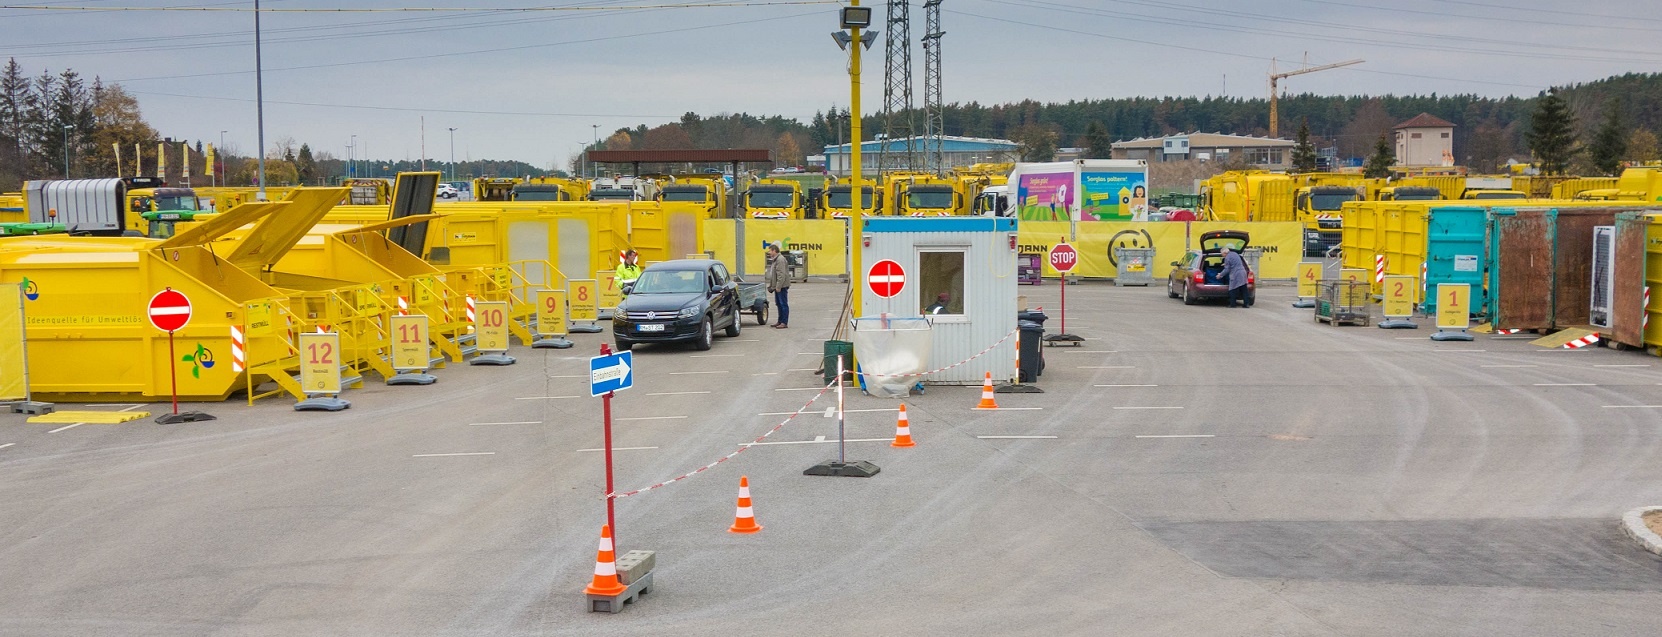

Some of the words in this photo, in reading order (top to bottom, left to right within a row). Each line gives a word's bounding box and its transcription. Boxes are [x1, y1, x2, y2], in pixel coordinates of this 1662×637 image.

[1086, 175, 1106, 183] Sorglos
[1051, 251, 1075, 264] STOP
[1305, 267, 1316, 281] 4
[606, 276, 615, 291] 7
[1393, 281, 1404, 297] 2
[577, 286, 588, 302] 8
[1448, 290, 1459, 307] 1
[545, 296, 556, 314] 9
[27, 316, 78, 325] Ideenquelle
[81, 315, 94, 323] für
[98, 315, 142, 323] Umweltlös
[481, 308, 503, 328] 10
[398, 323, 422, 344] 11
[307, 342, 333, 365] 12
